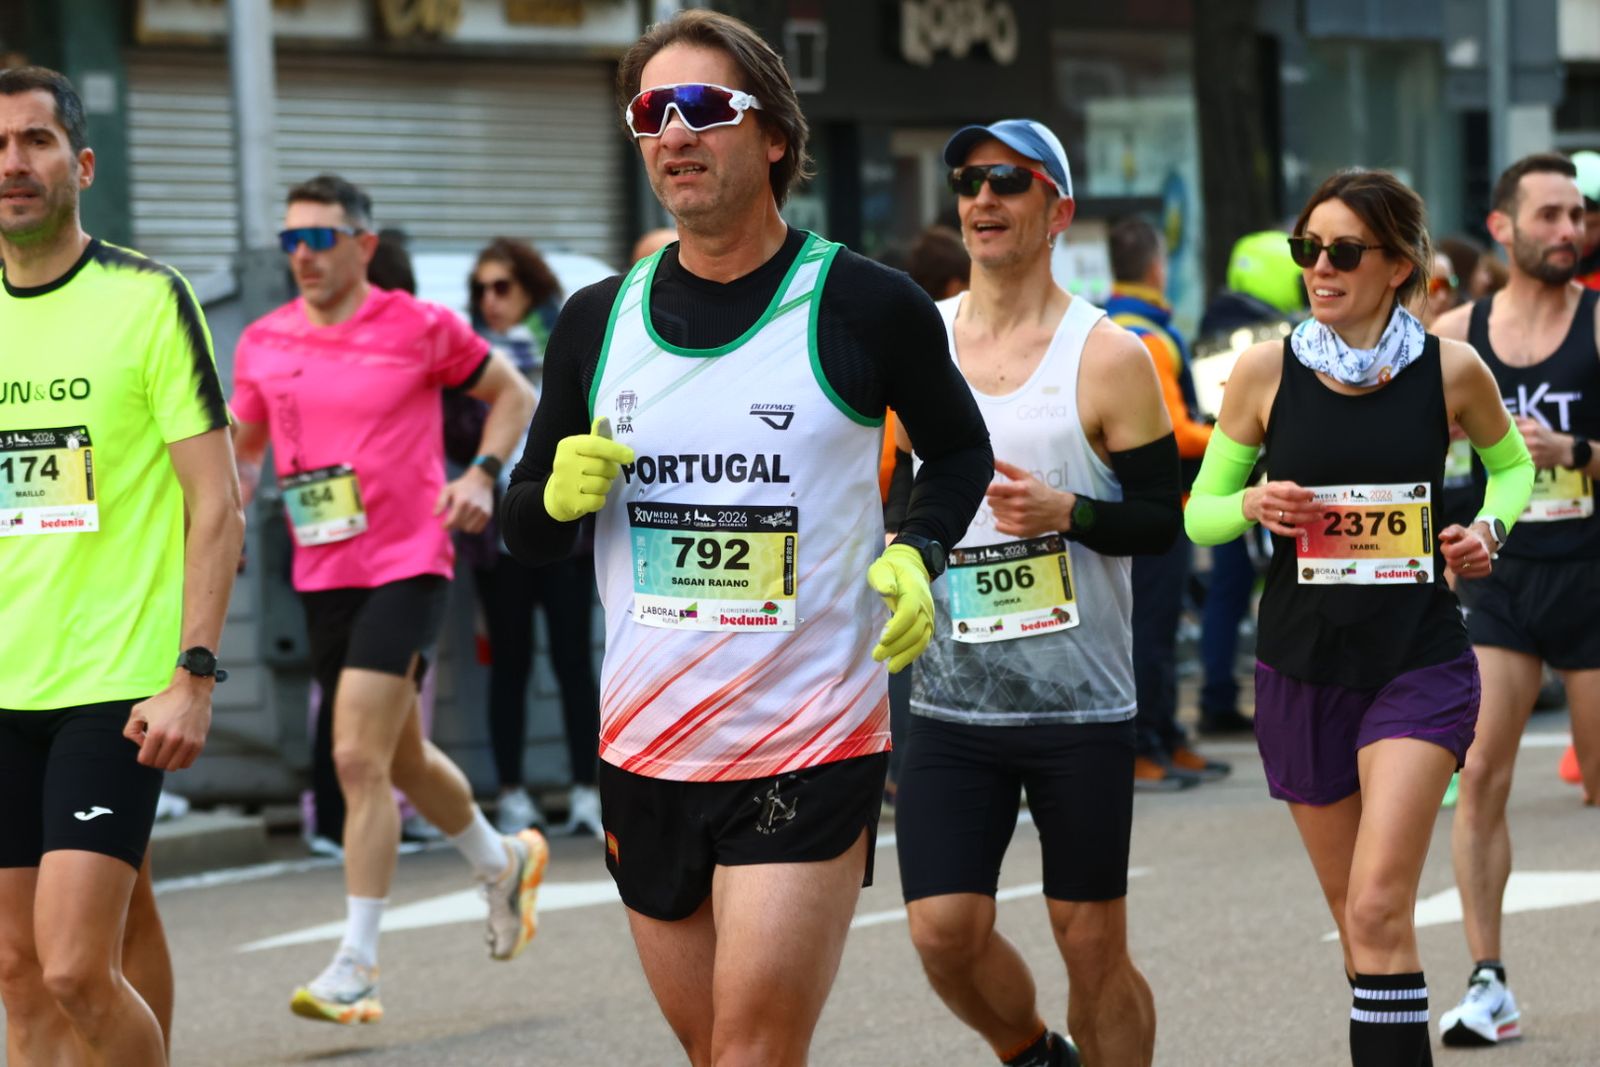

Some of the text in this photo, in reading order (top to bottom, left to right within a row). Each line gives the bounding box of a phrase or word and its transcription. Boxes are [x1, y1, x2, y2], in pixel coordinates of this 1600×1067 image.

[750, 403, 795, 411] OUTPACE
[616, 424, 634, 434] FPA
[31, 432, 56, 443] 2026
[0, 454, 60, 483] 174
[621, 453, 790, 485] PORTUGAL
[15, 489, 46, 498] MAILLO
[1370, 490, 1393, 499] 2026
[634, 511, 654, 523] XIV
[653, 511, 679, 520] MEDIA
[717, 511, 748, 523] 2026
[41, 519, 85, 529] bedunia
[1323, 510, 1407, 537] 2376
[671, 536, 750, 570] 792
[1003, 544, 1028, 557] 2026
[1350, 543, 1381, 551] IXABEL
[671, 576, 749, 588] SAGAN RAIANO
[976, 564, 1035, 595] 506
[993, 597, 1022, 607] GORKA
[642, 605, 678, 618] LABORAL
[719, 613, 778, 626] bedunia
